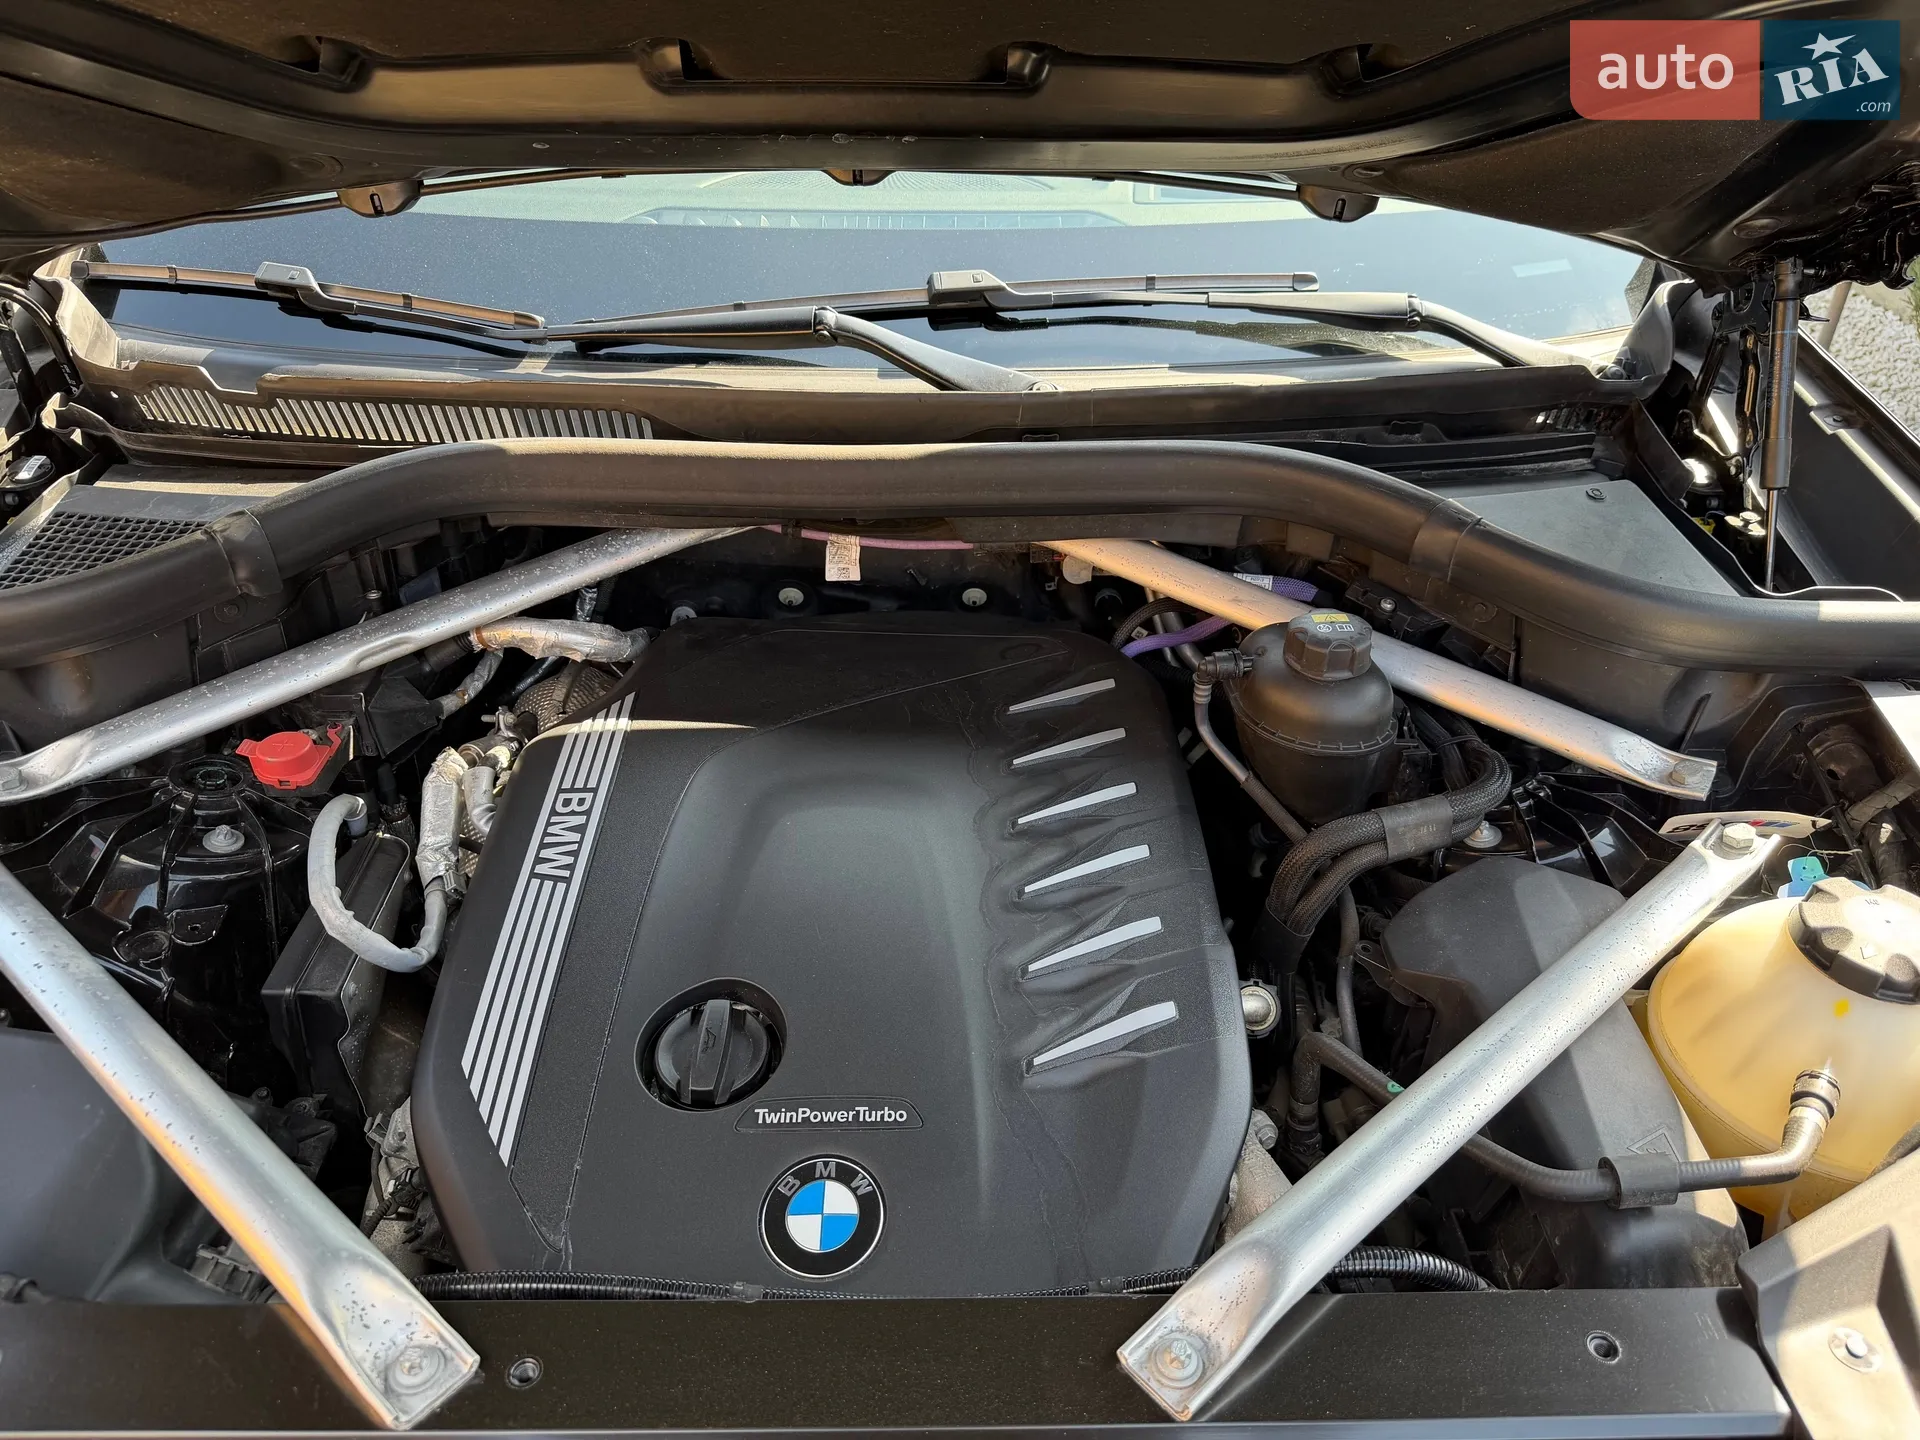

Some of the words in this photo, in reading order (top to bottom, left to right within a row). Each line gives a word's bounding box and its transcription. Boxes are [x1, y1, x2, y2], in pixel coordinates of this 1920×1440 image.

[533, 792, 594, 878] BMW
[754, 1106, 908, 1124] TwinPowerTurbo
[777, 1161, 874, 1197] BMW
